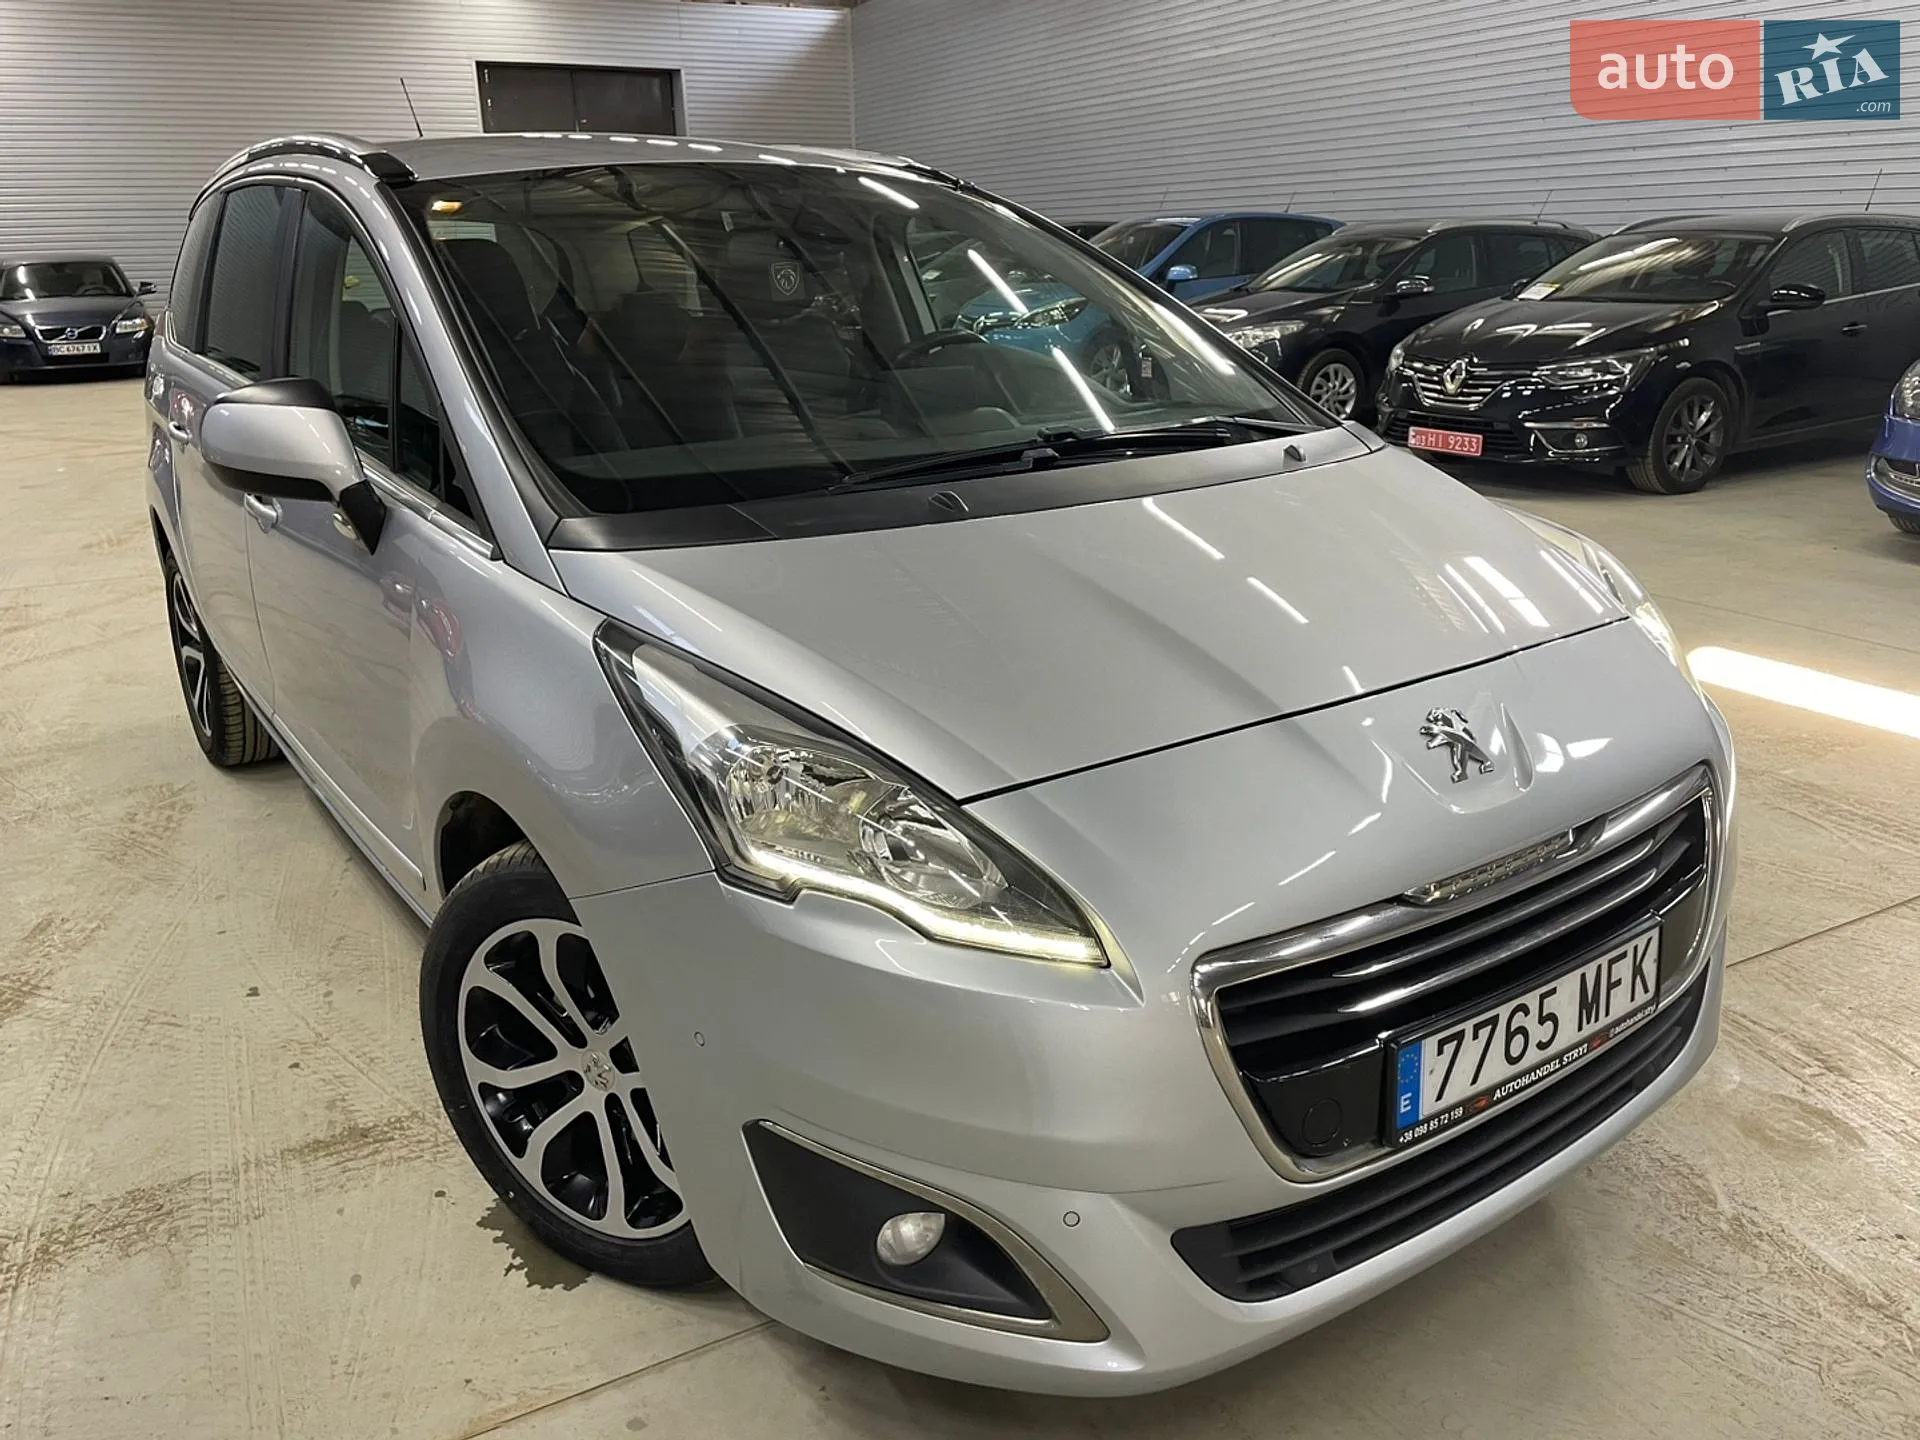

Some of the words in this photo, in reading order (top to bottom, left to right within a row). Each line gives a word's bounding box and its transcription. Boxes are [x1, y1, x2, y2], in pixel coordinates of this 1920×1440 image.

[1427, 432, 1444, 448] HI
[1447, 435, 1478, 452] 9233
[1435, 986, 1559, 1103] 7765
[1577, 936, 1653, 1033] MFK
[1493, 1058, 1561, 1101] AUTOHANDEL
[1400, 1092, 1412, 1113] E
[1399, 1130, 1413, 1143] +38
[1414, 1123, 1428, 1138] 098
[1429, 1118, 1439, 1131] 85
[1440, 1113, 1449, 1126] 72
